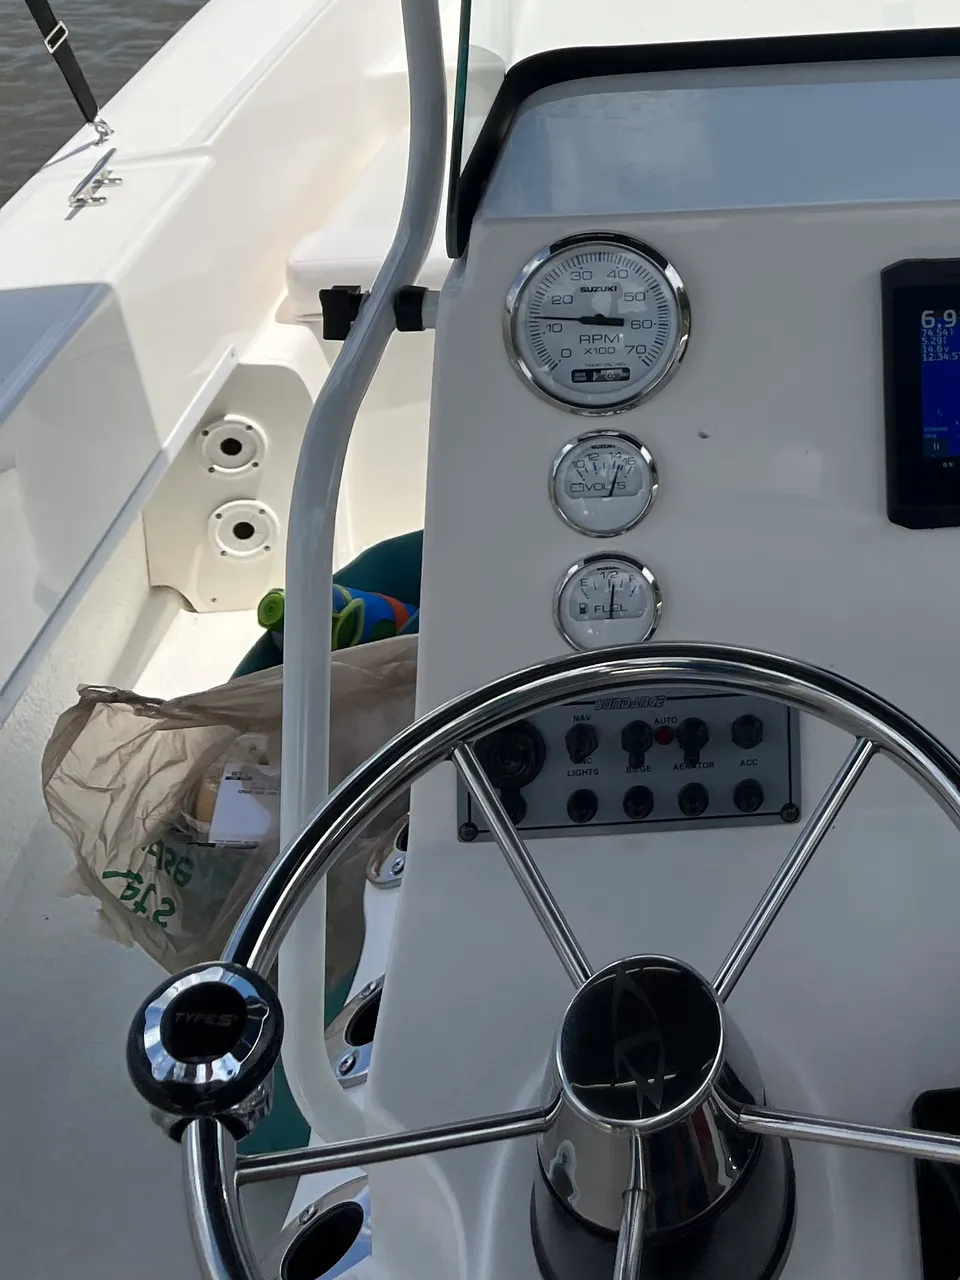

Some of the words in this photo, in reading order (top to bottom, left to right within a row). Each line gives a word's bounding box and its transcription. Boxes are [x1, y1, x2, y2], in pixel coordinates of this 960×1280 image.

[570, 270, 593, 281] 30
[606, 270, 629, 279] 40
[580, 285, 618, 293] SUZUKI
[551, 294, 574, 305] 20
[623, 292, 646, 302] 50
[921, 309, 957, 328] 6.9
[546, 323, 563, 333] 10
[630, 320, 653, 330] 60
[579, 333, 620, 345] RPM
[560, 348, 572, 358] 0
[584, 346, 616, 355] X100
[624, 345, 647, 355] 70
[585, 452, 600, 461] 12
[609, 451, 622, 459] 14
[572, 460, 586, 469] 10
[622, 457, 636, 466] 16
[600, 570, 619, 580] 1/2
[580, 578, 588, 587] E
[594, 603, 628, 613] FUEL
[594, 695, 667, 710] SUNDANCE
[572, 714, 591, 723] NAV
[653, 716, 678, 725] AUTO
[739, 758, 759, 767] ACC
[567, 768, 599, 777] LIGHTS
